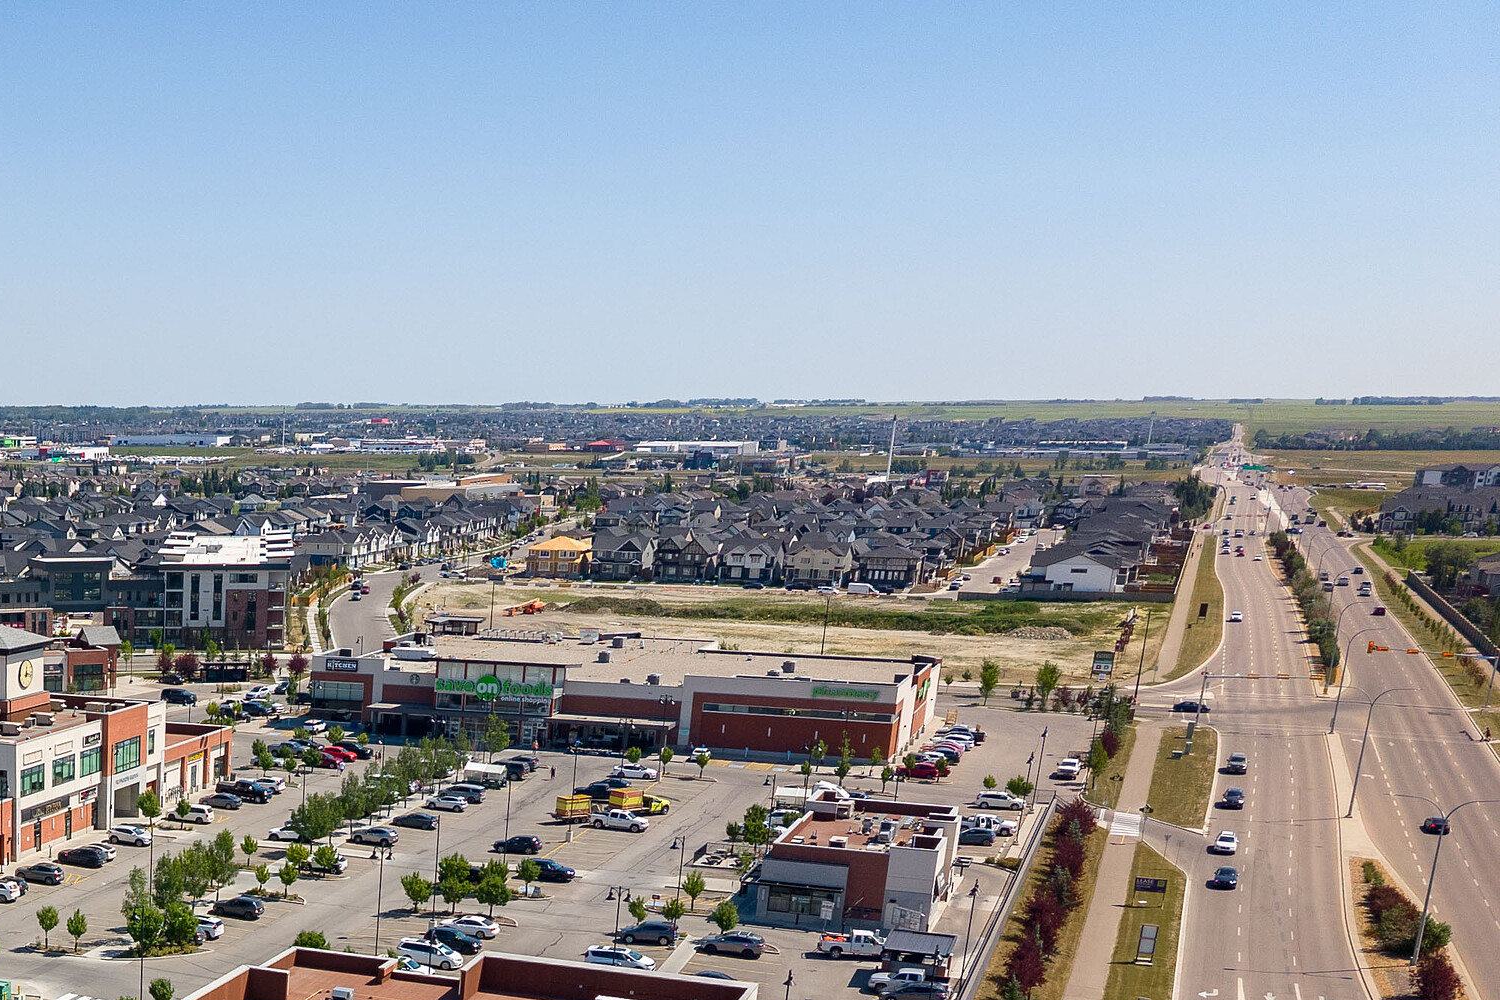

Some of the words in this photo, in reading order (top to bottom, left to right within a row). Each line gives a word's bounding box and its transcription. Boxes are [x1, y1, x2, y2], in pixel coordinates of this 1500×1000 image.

[435, 679, 474, 692] save
[476, 682, 498, 694] on
[502, 680, 553, 697] foods
[521, 696, 552, 704] shopping
